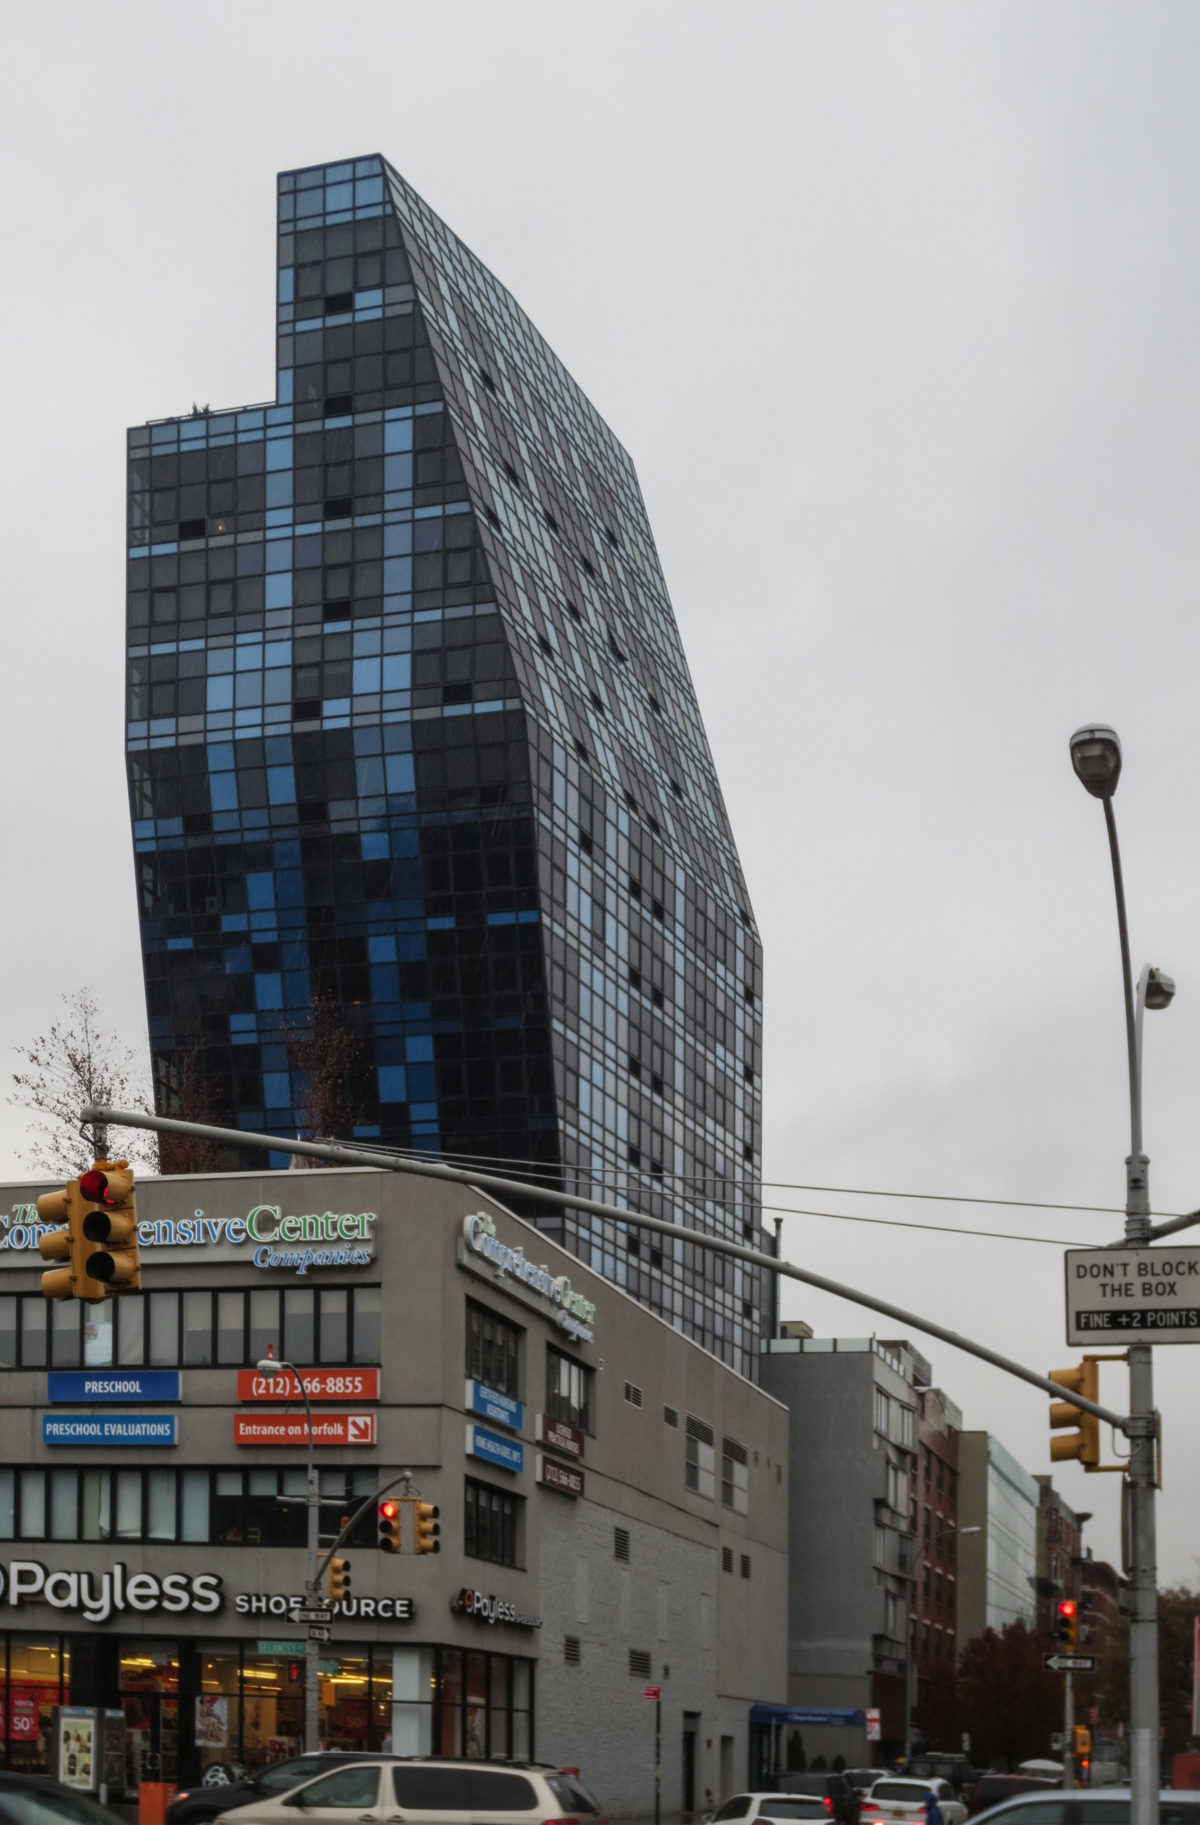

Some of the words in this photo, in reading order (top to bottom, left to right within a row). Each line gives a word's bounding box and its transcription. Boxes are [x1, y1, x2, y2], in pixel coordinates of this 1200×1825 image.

[12, 1204, 42, 1224] Th
[246, 1205, 376, 1242] Center
[253, 1245, 371, 1275] Companies
[1076, 1263, 1129, 1278] DON'T
[1137, 1261, 1199, 1277] BLOCK
[1099, 1282, 1135, 1298] THE
[1142, 1281, 1177, 1297] BOX
[1080, 1313, 1112, 1328] FINE
[1147, 1311, 1198, 1326] POINTS
[85, 1381, 142, 1393] PRESCHOOL
[252, 1377, 290, 1395] (212)
[294, 1377, 362, 1394] 566-8855
[46, 1424, 101, 1436] PRESCHOOL
[104, 1424, 170, 1436] EVALUATIONS
[239, 1423, 286, 1436] Entrance
[288, 1427, 301, 1436] on
[9, 1561, 222, 1622] Payless
[474, 1591, 516, 1624] Payless
